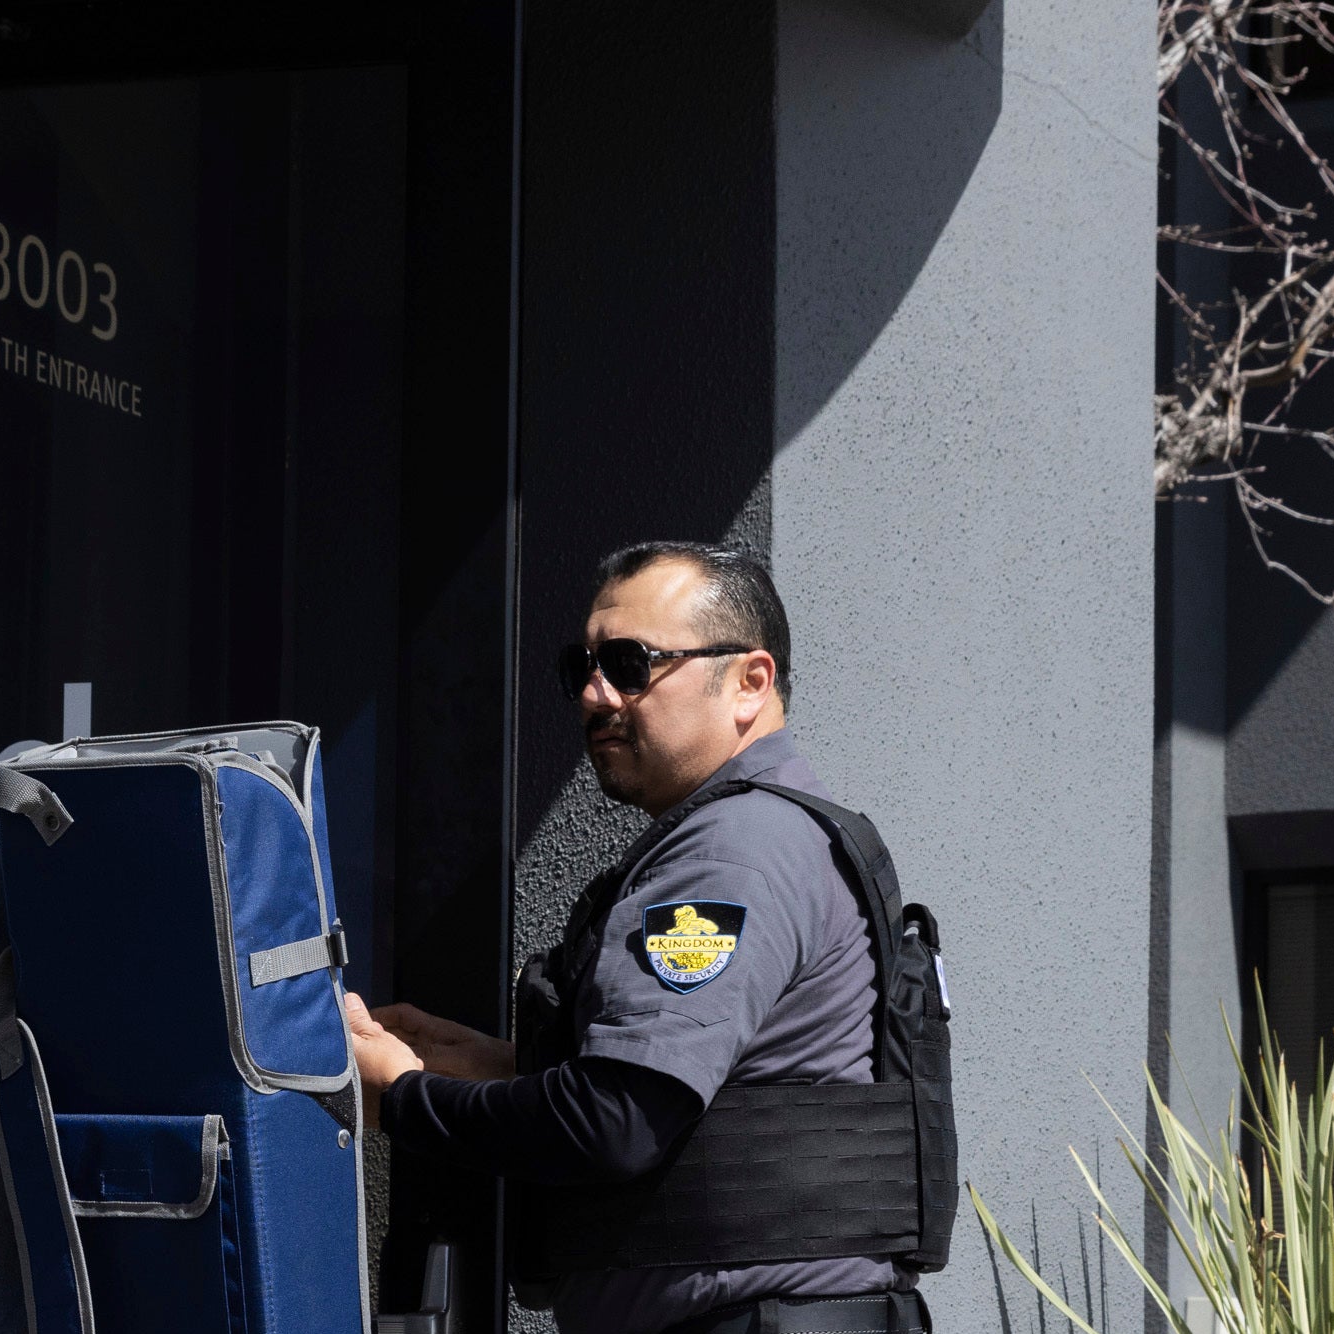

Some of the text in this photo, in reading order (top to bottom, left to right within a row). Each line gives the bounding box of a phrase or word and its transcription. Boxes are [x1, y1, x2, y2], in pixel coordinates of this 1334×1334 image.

[36, 350, 142, 417] ENTRANCE
[654, 959, 725, 981] PRIVATE SECURITY
